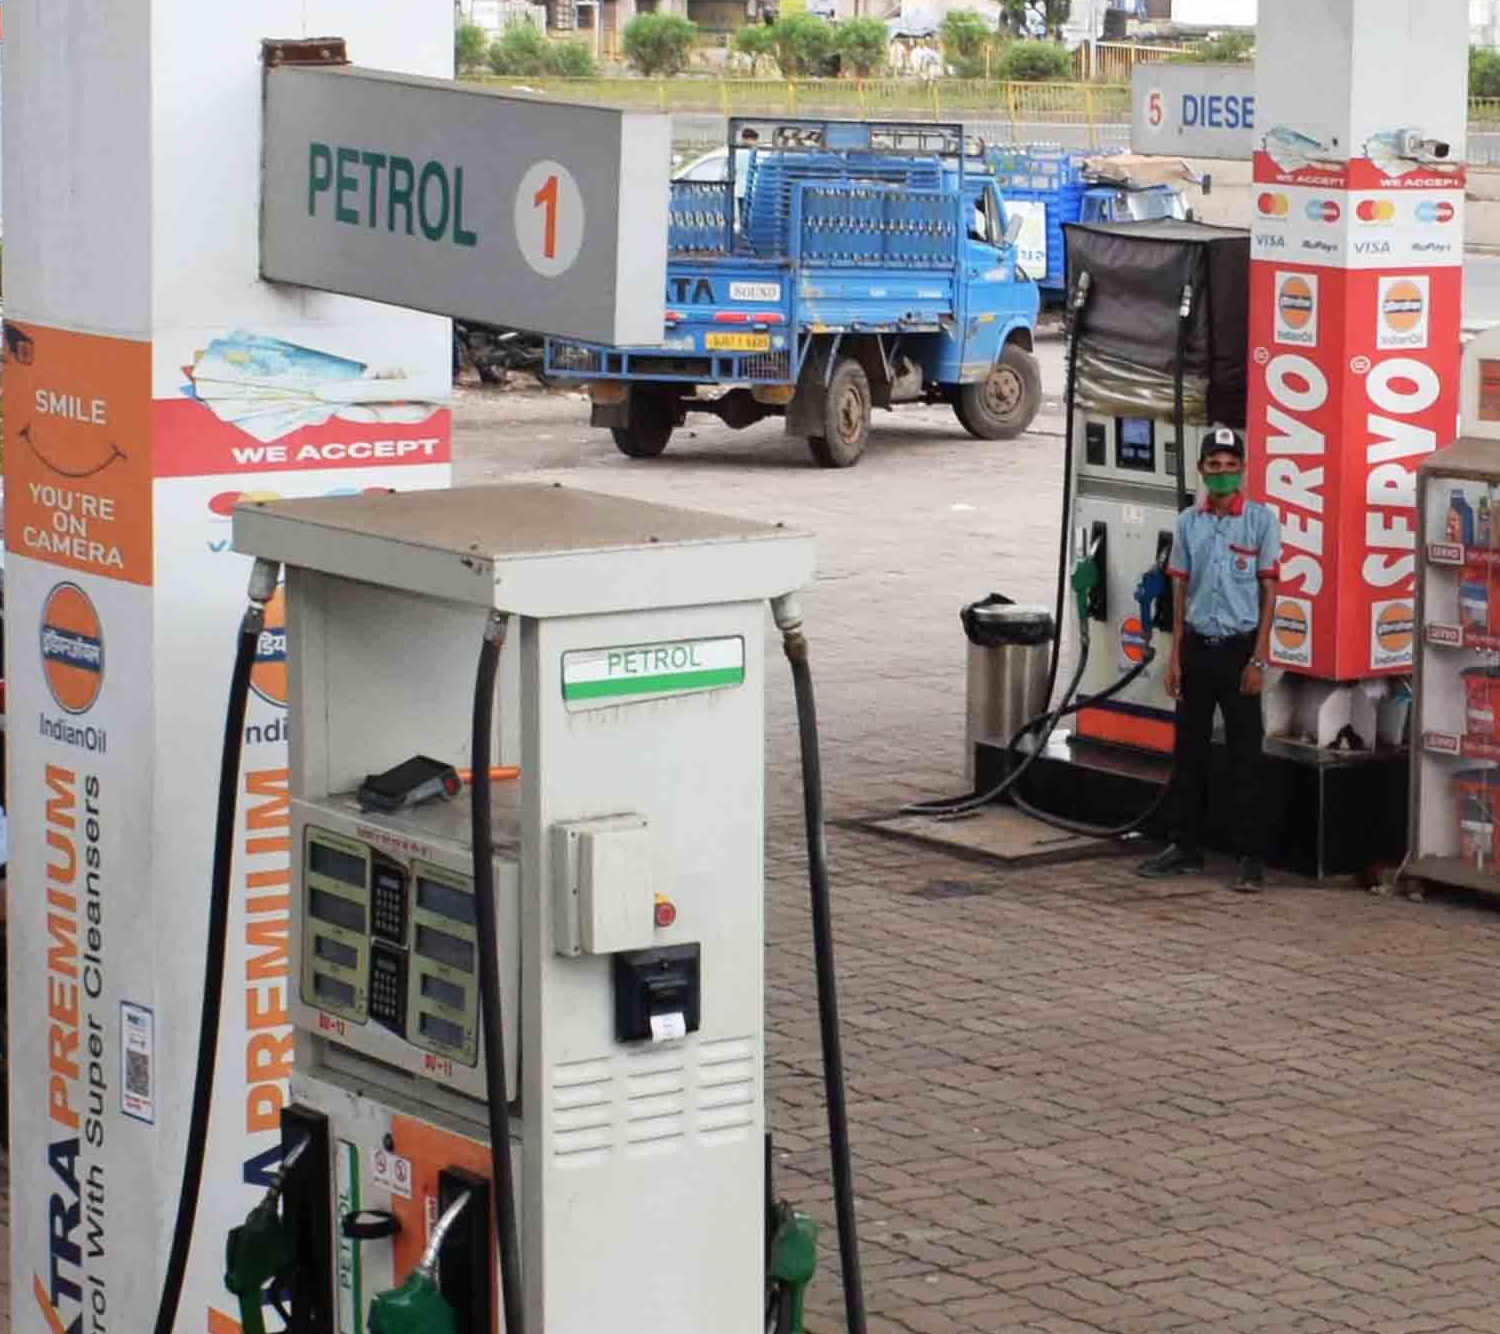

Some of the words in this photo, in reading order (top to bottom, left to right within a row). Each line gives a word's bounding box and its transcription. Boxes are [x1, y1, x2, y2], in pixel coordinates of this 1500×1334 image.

[1147, 92, 1163, 127] 5
[1181, 95, 1255, 129] DIESE
[307, 141, 479, 247] PETROL
[532, 175, 559, 260] 1
[1256, 234, 1285, 247] VISA
[1354, 241, 1392, 254] VISA
[35, 390, 107, 426] SMILE
[231, 444, 288, 466] WE
[296, 438, 441, 462] ACCEPT
[1266, 353, 1329, 597] SERVO
[1362, 357, 1442, 592] SERVO
[29, 483, 116, 521] YOU'RE
[52, 511, 88, 538] ON
[23, 526, 124, 569] CAMERA
[607, 644, 702, 675] PETROL
[39, 712, 107, 755] IndianOil
[80, 773, 102, 999] Cleansers
[84, 1016, 107, 1149] Super
[84, 1165, 106, 1259] With
[338, 1193, 352, 1290] PETOL
